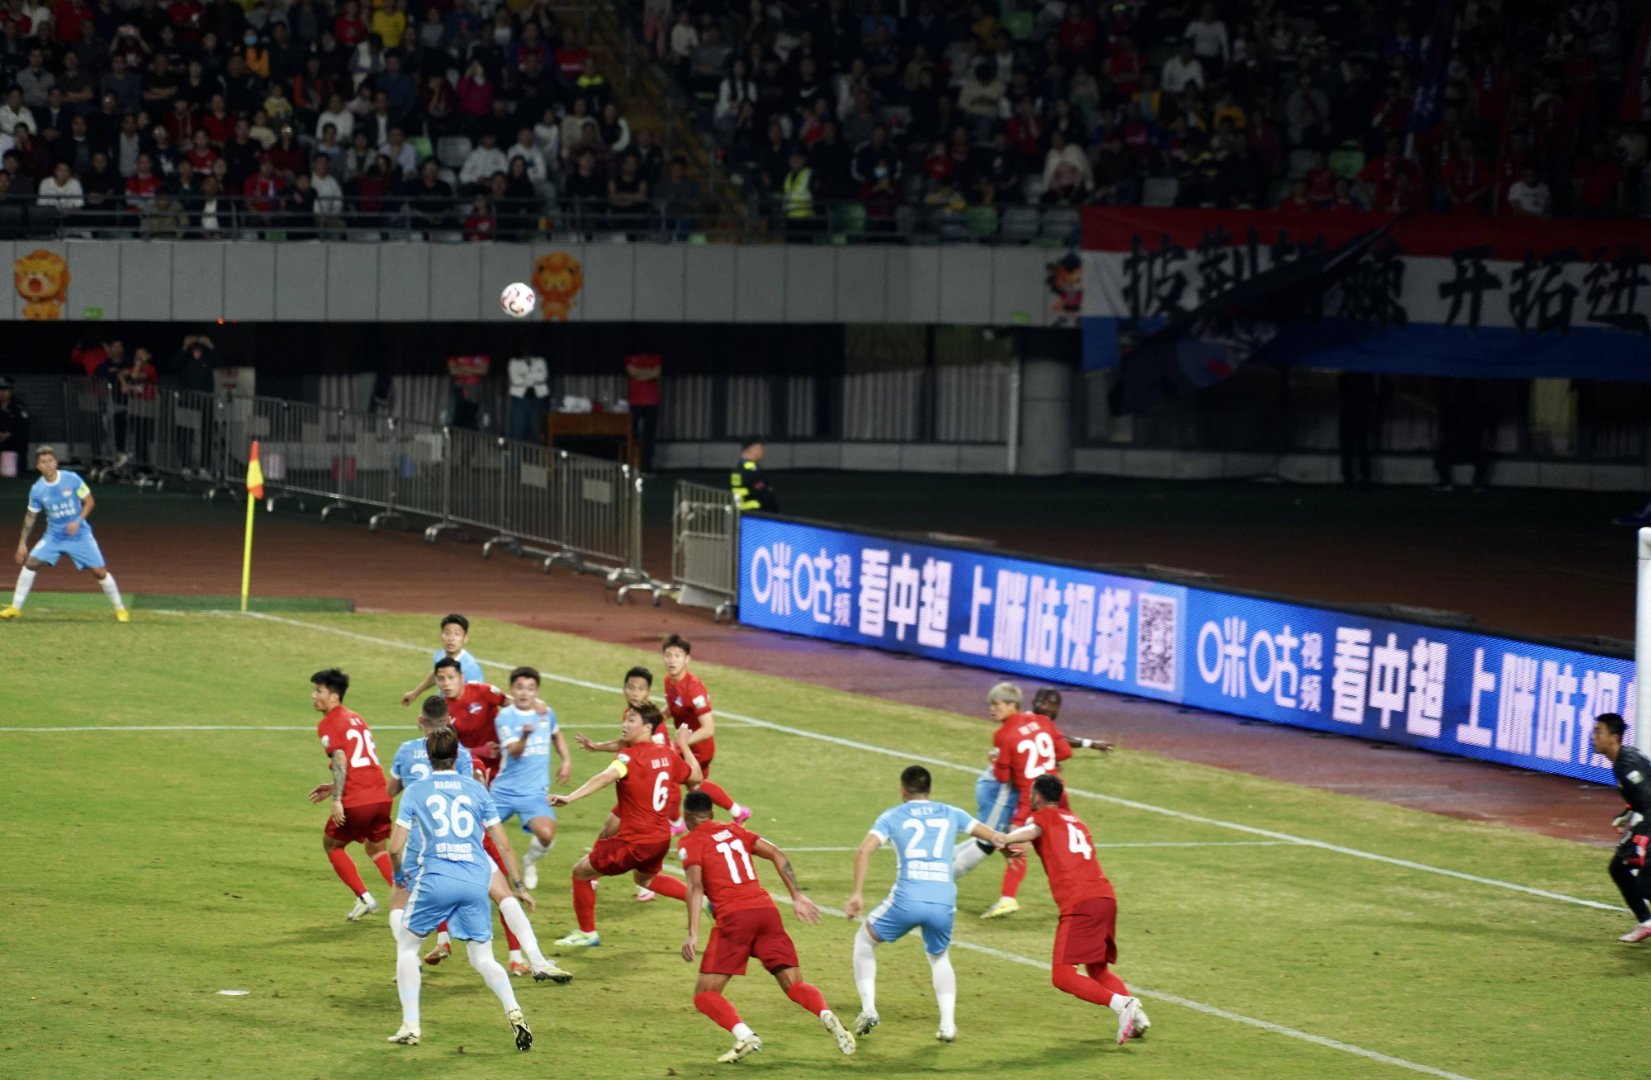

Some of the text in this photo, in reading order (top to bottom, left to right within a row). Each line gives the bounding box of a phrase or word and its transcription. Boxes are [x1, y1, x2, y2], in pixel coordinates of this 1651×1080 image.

[1123, 224, 1408, 328] 披荆棘
[858, 548, 952, 649] 看中超
[1332, 627, 1448, 739] 看中超
[1017, 732, 1056, 779] 29
[653, 771, 669, 811] 6
[425, 794, 474, 838] 36
[902, 818, 950, 859] 27
[715, 839, 756, 884] 11
[1066, 823, 1092, 860] 4
